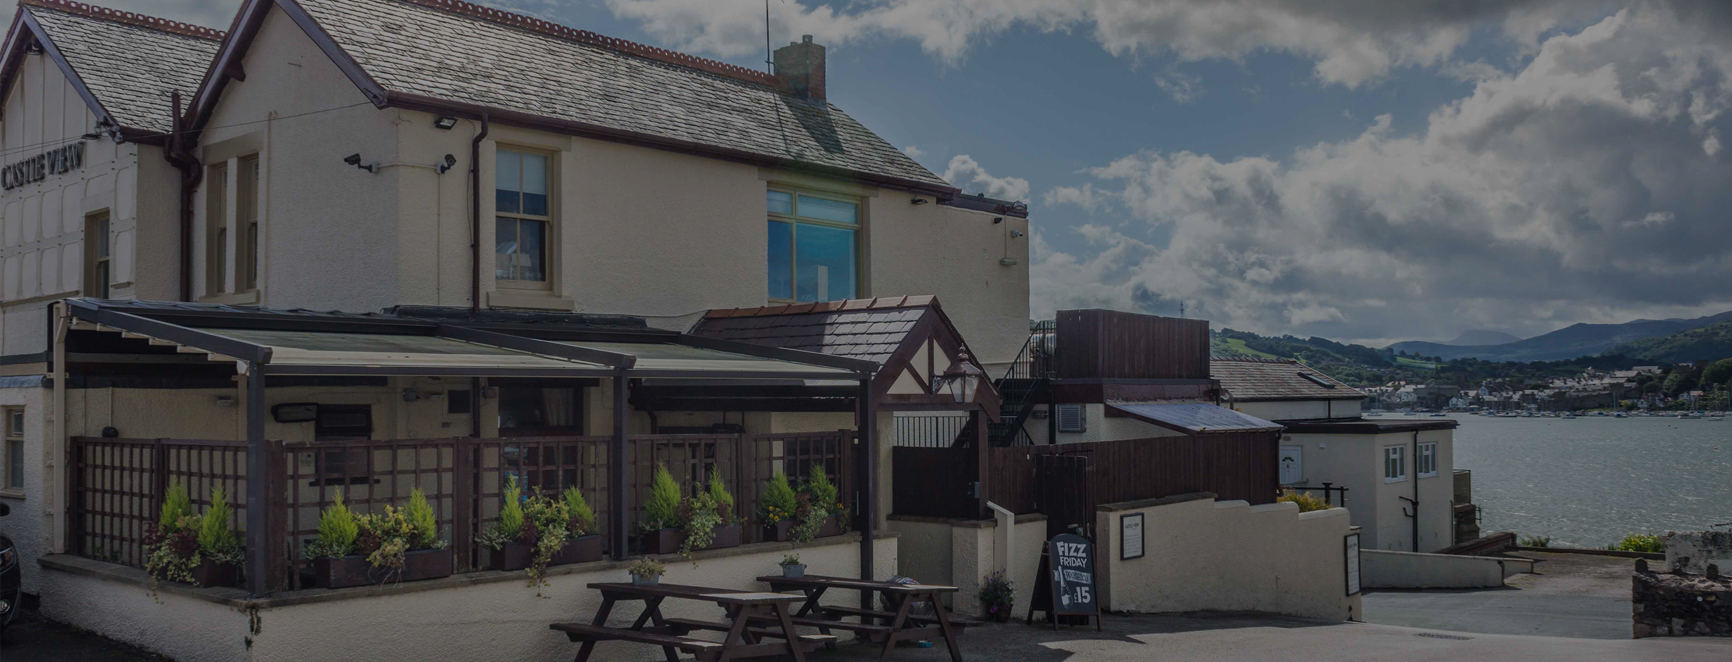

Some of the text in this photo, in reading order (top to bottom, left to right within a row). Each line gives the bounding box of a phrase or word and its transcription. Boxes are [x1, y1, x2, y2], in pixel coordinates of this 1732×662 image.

[1, 141, 85, 191] CASTLE VIEW
[1056, 541, 1087, 557] FIZZ
[1060, 557, 1087, 568] FRIDAY
[1074, 586, 1091, 604] £15
